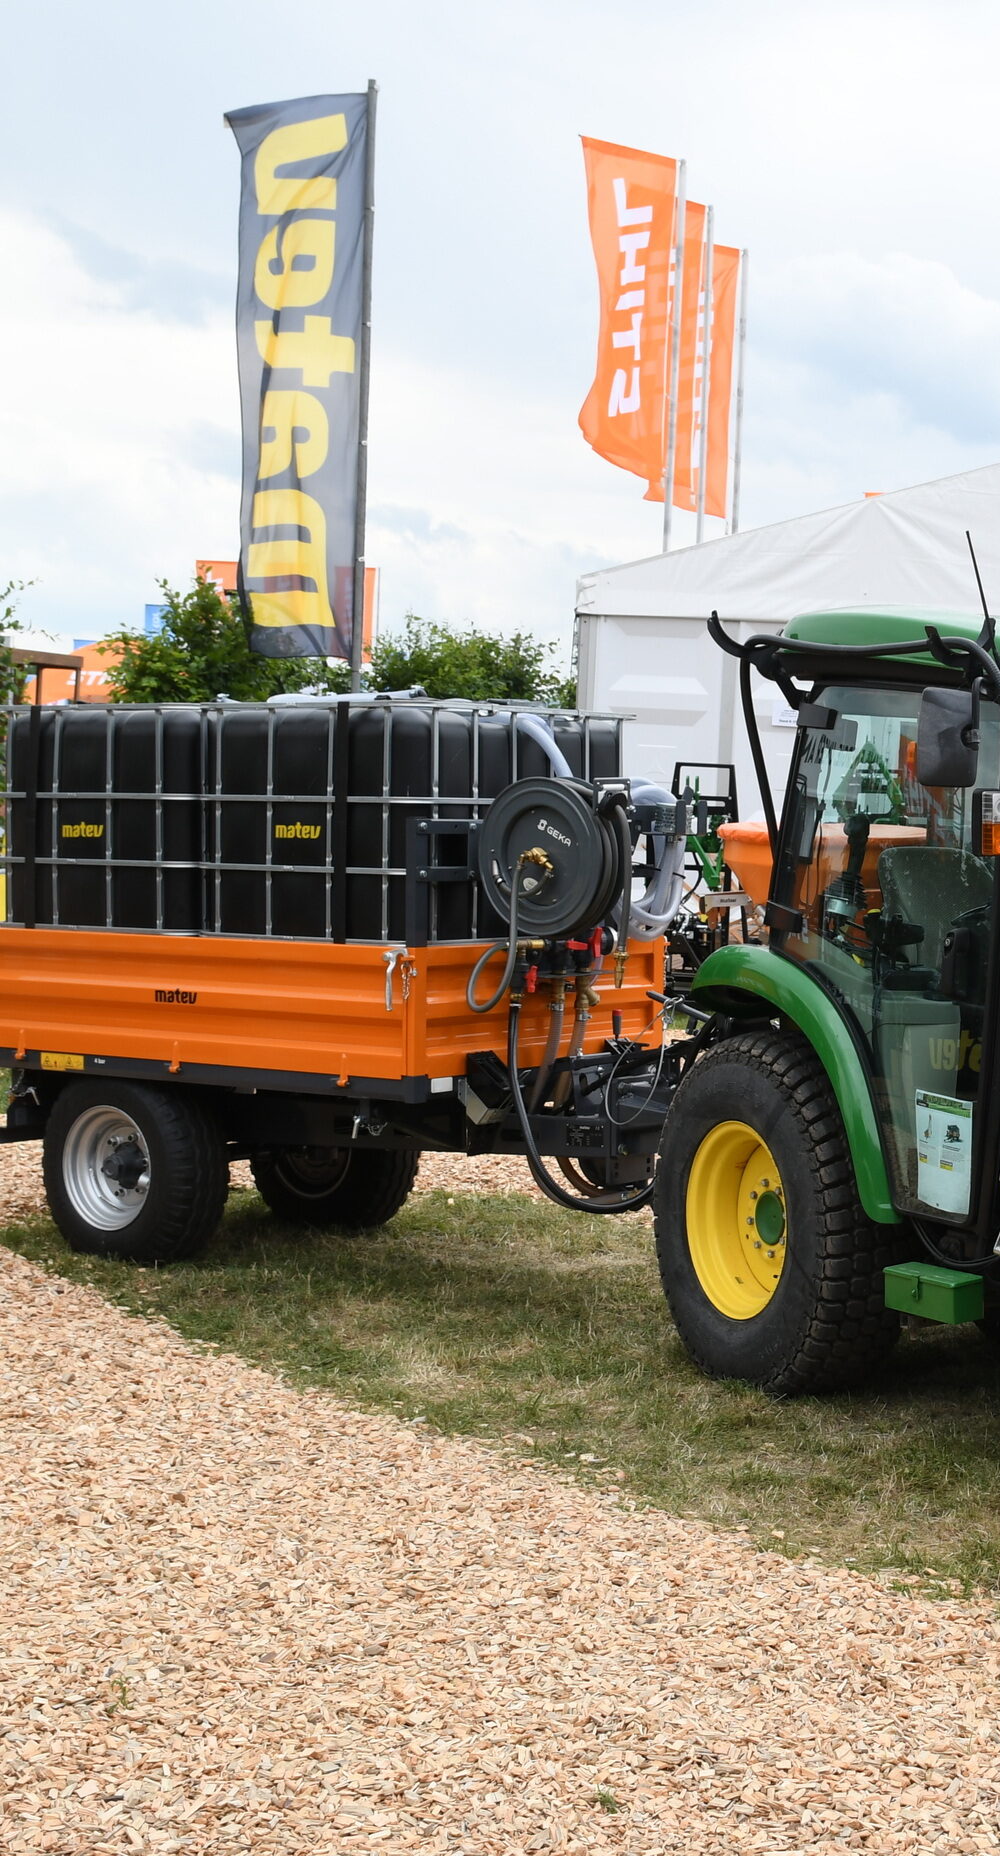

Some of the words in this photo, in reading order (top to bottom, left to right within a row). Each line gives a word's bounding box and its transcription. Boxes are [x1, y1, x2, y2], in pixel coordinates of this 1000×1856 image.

[62, 821, 103, 838] matev
[275, 822, 320, 839] matev
[546, 826, 572, 847] GEKA
[155, 988, 197, 1004] matev
